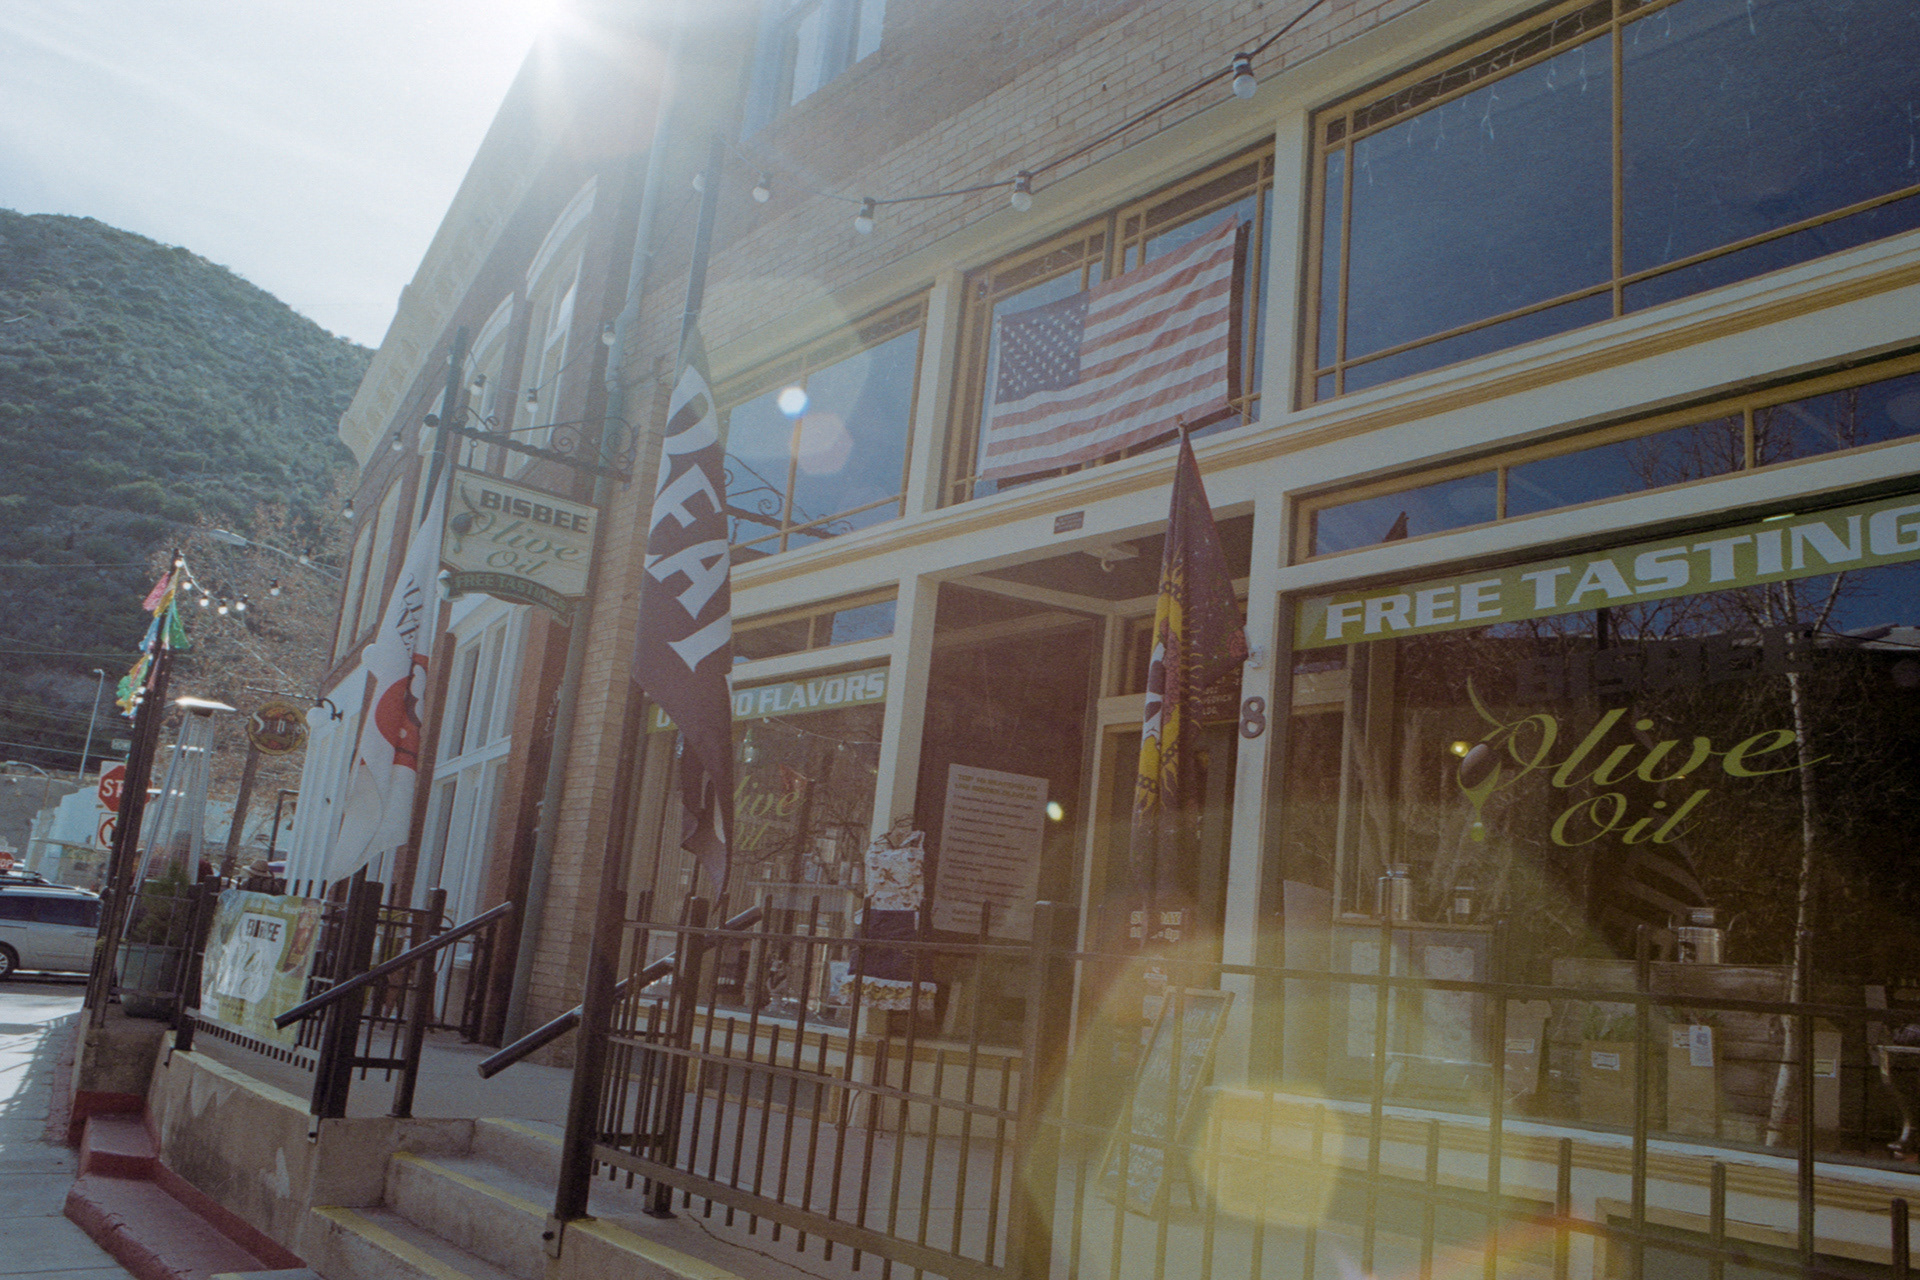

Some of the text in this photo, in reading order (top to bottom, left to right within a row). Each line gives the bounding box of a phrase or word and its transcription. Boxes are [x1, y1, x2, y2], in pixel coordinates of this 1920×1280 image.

[480, 489, 588, 534] BISBEE
[458, 510, 589, 562] Olive
[486, 550, 548, 576] Oil
[455, 573, 568, 614] FREE TASTINGS
[1325, 579, 1502, 641] FREE
[758, 672, 886, 715] FLAVORS
[1241, 696, 1266, 739] 8
[1485, 707, 1832, 789] Olive
[102, 779, 124, 798] ST
[733, 775, 806, 817] live
[1550, 789, 1711, 847] Oil
